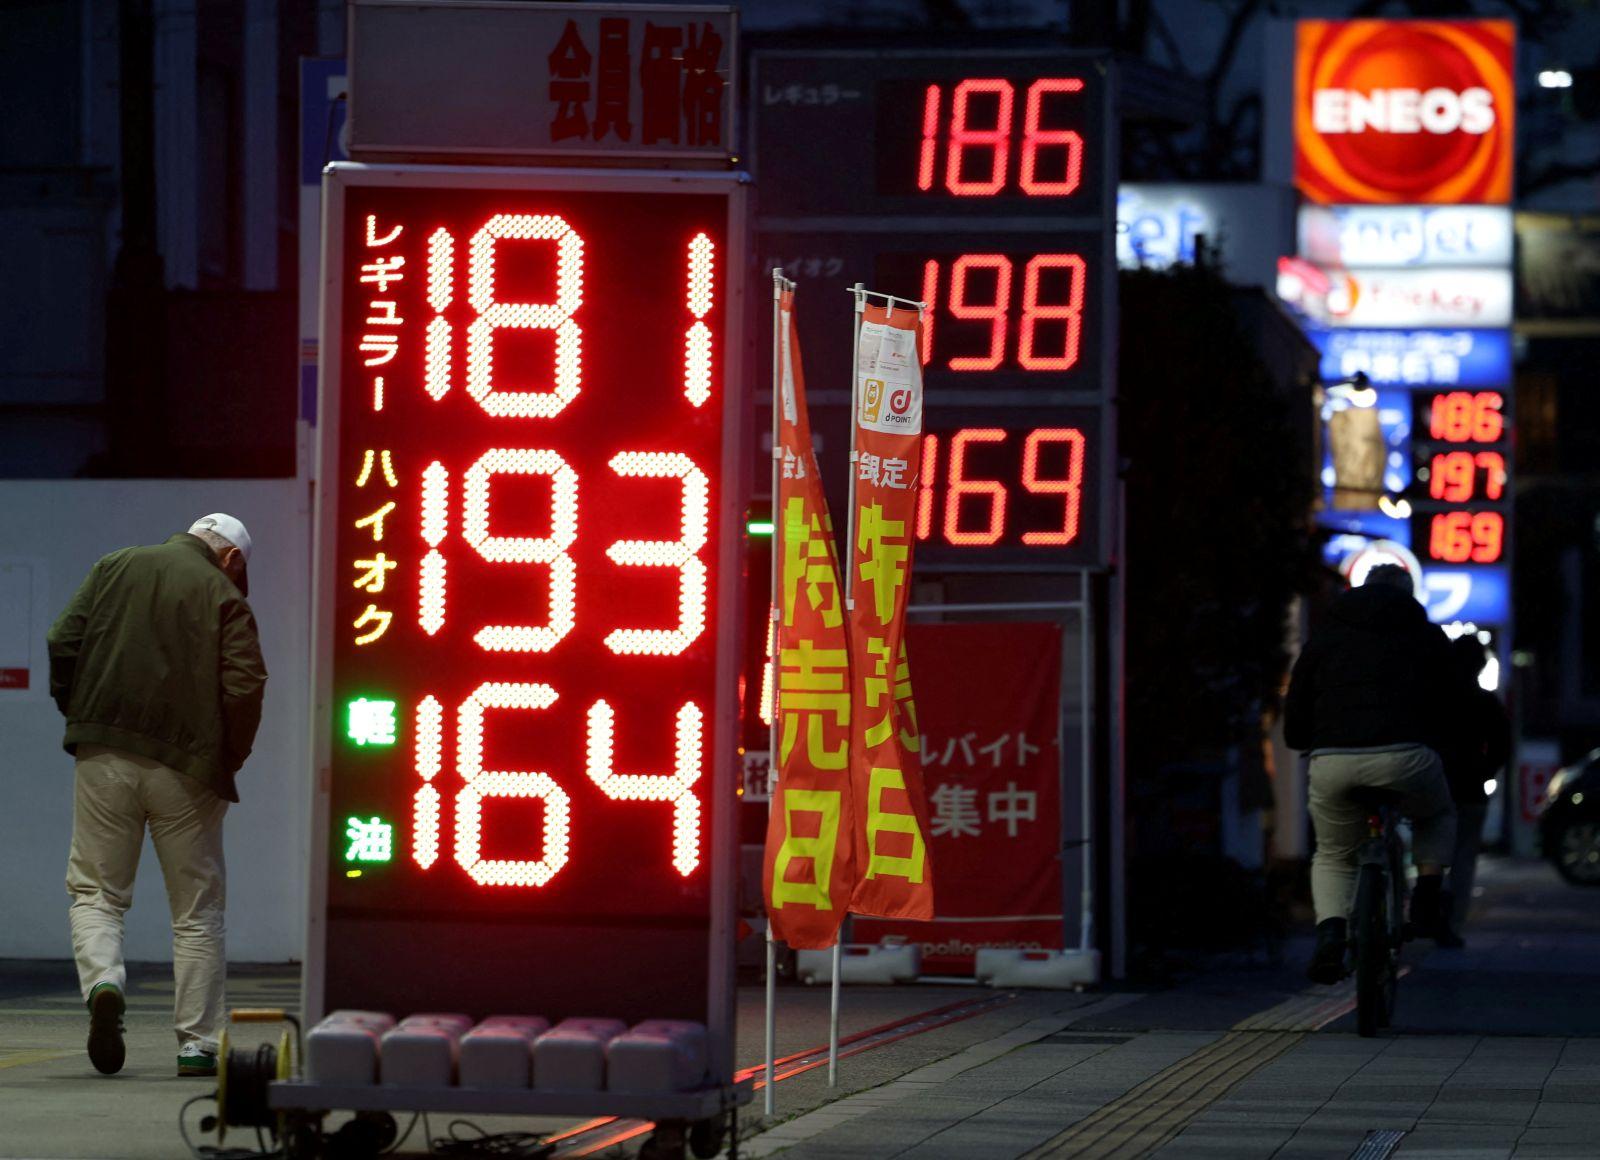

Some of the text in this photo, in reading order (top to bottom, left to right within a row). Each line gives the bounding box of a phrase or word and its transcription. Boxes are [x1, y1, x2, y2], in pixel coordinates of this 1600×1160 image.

[548, 18, 724, 146] 会員価格
[764, 83, 861, 106] レギュラー
[918, 78, 1084, 196] 186
[1313, 88, 1495, 135] ENEOS
[359, 214, 404, 412] レギュラー
[424, 213, 714, 418] 181
[921, 253, 1086, 372] 198
[1429, 391, 1504, 443] 186
[916, 428, 1086, 545] 169
[1429, 451, 1506, 503] 197
[353, 449, 398, 646] ハイオク
[419, 447, 709, 656] 193
[1429, 511, 1504, 563] 169
[346, 697, 396, 862] 軽油
[412, 681, 703, 888] 164
[930, 782, 1037, 838] 集中
